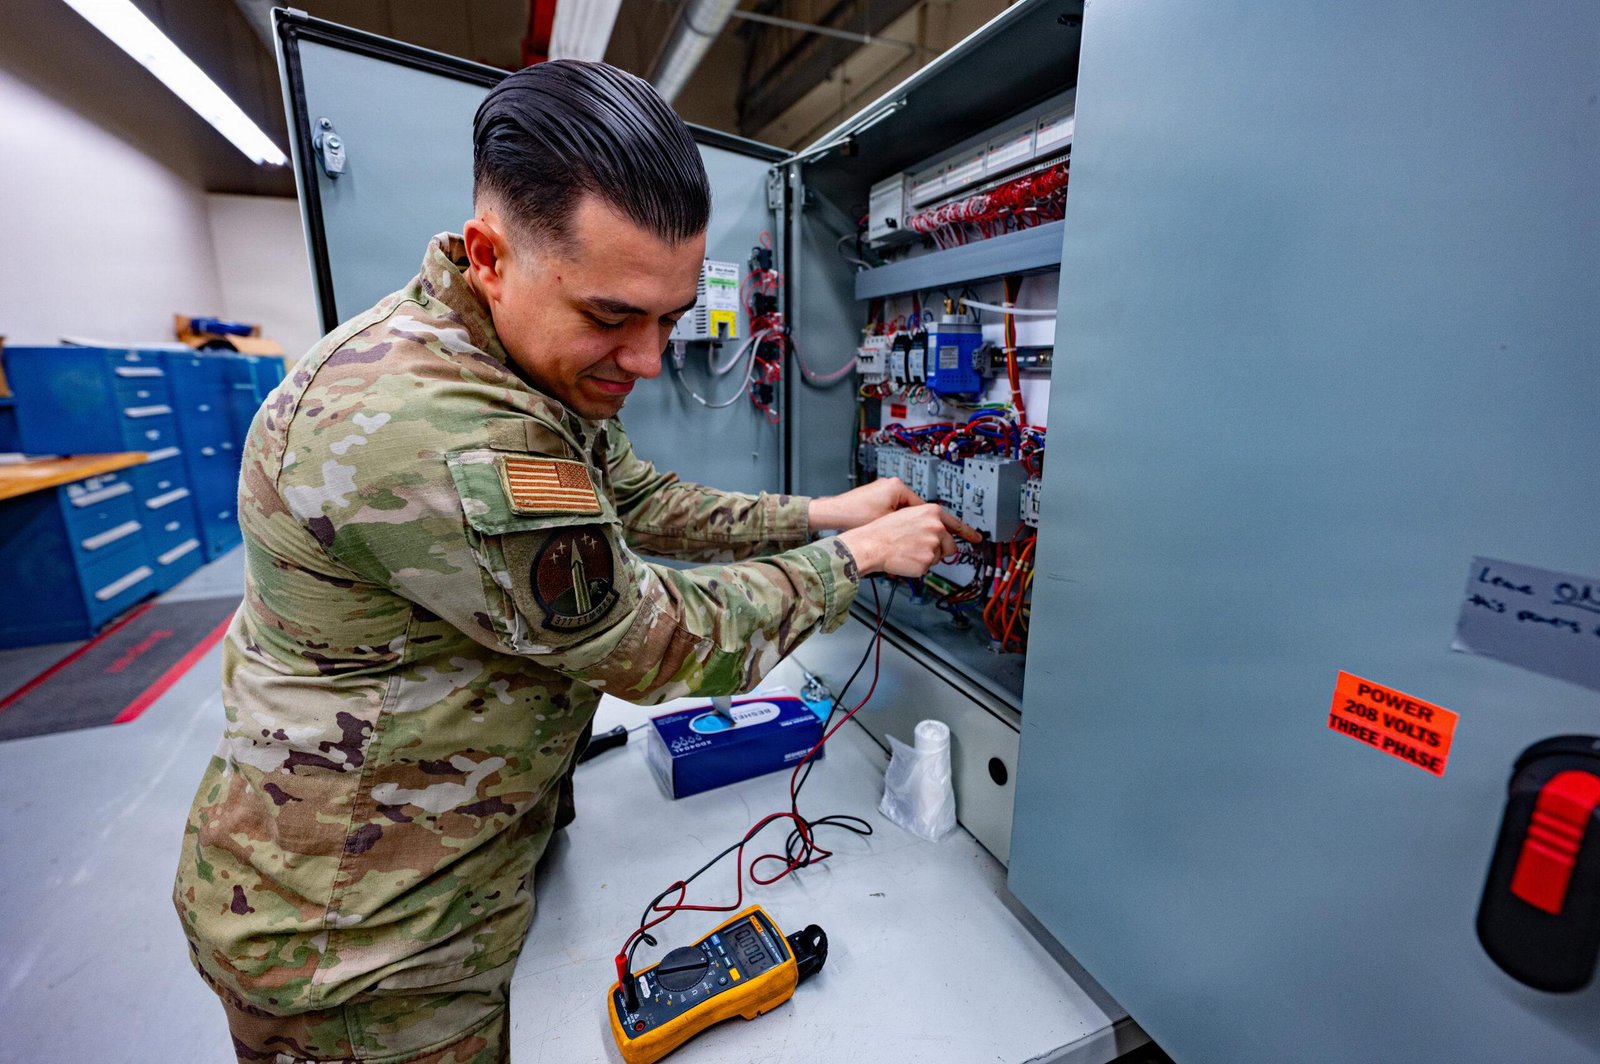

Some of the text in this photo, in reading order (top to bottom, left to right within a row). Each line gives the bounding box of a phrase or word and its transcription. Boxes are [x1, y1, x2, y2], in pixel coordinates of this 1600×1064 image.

[1344, 699, 1442, 747] 208 VOLTS
[1357, 682, 1434, 723] POWER
[1330, 713, 1444, 773] THREE PHASE
